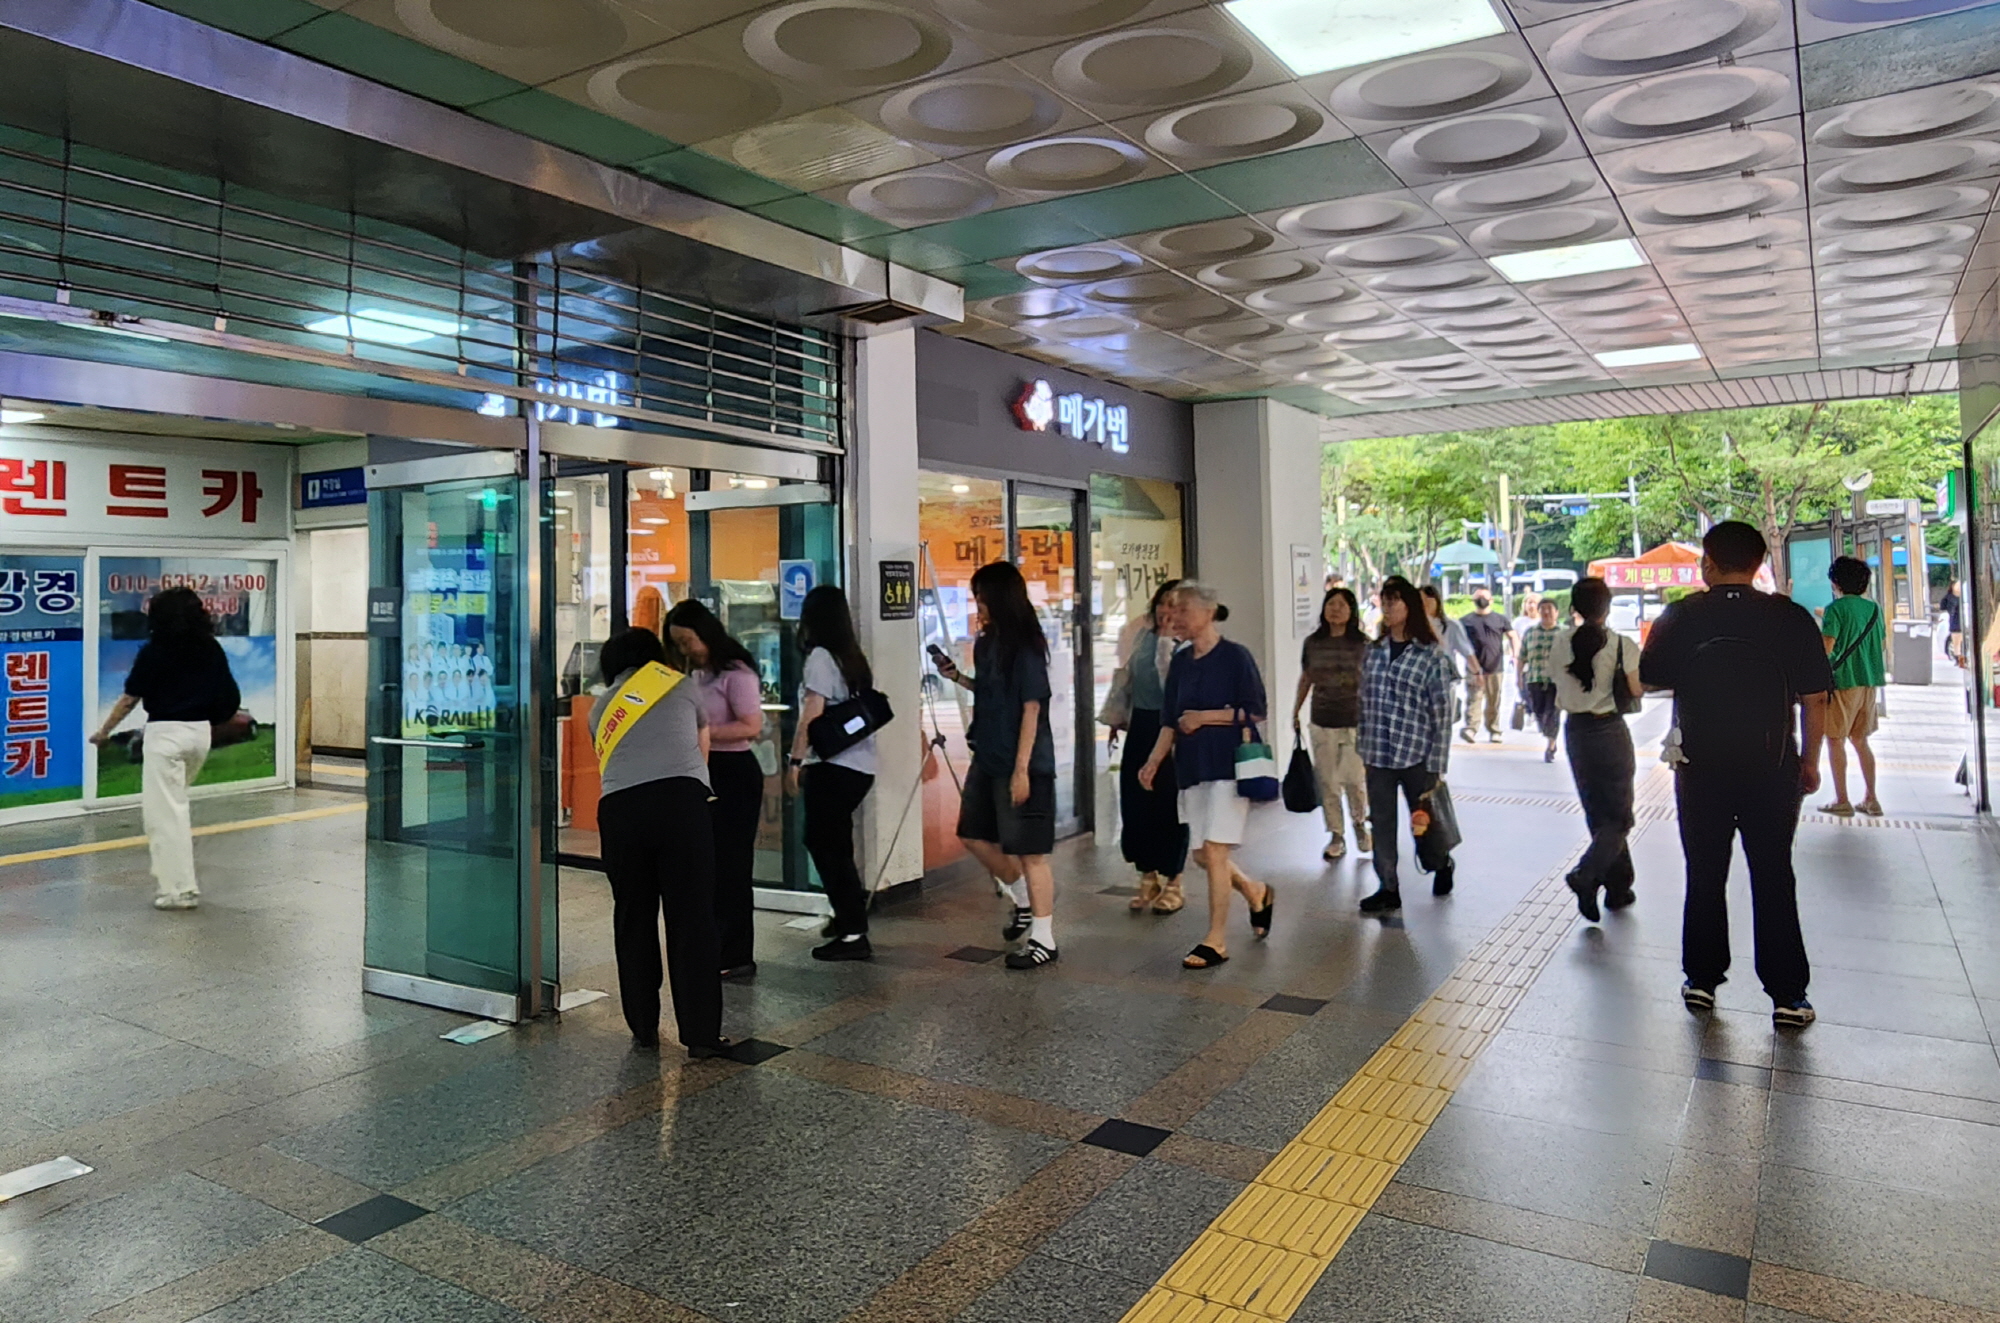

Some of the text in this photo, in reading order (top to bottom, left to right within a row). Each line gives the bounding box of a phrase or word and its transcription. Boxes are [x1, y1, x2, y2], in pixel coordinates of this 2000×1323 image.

[1059, 393, 1129, 454] 메가번
[0, 458, 263, 523] 렌트카
[108, 573, 266, 594] 010-6352-1500
[1624, 567, 1673, 584] 계란빵
[5, 651, 52, 778] 렌트카
